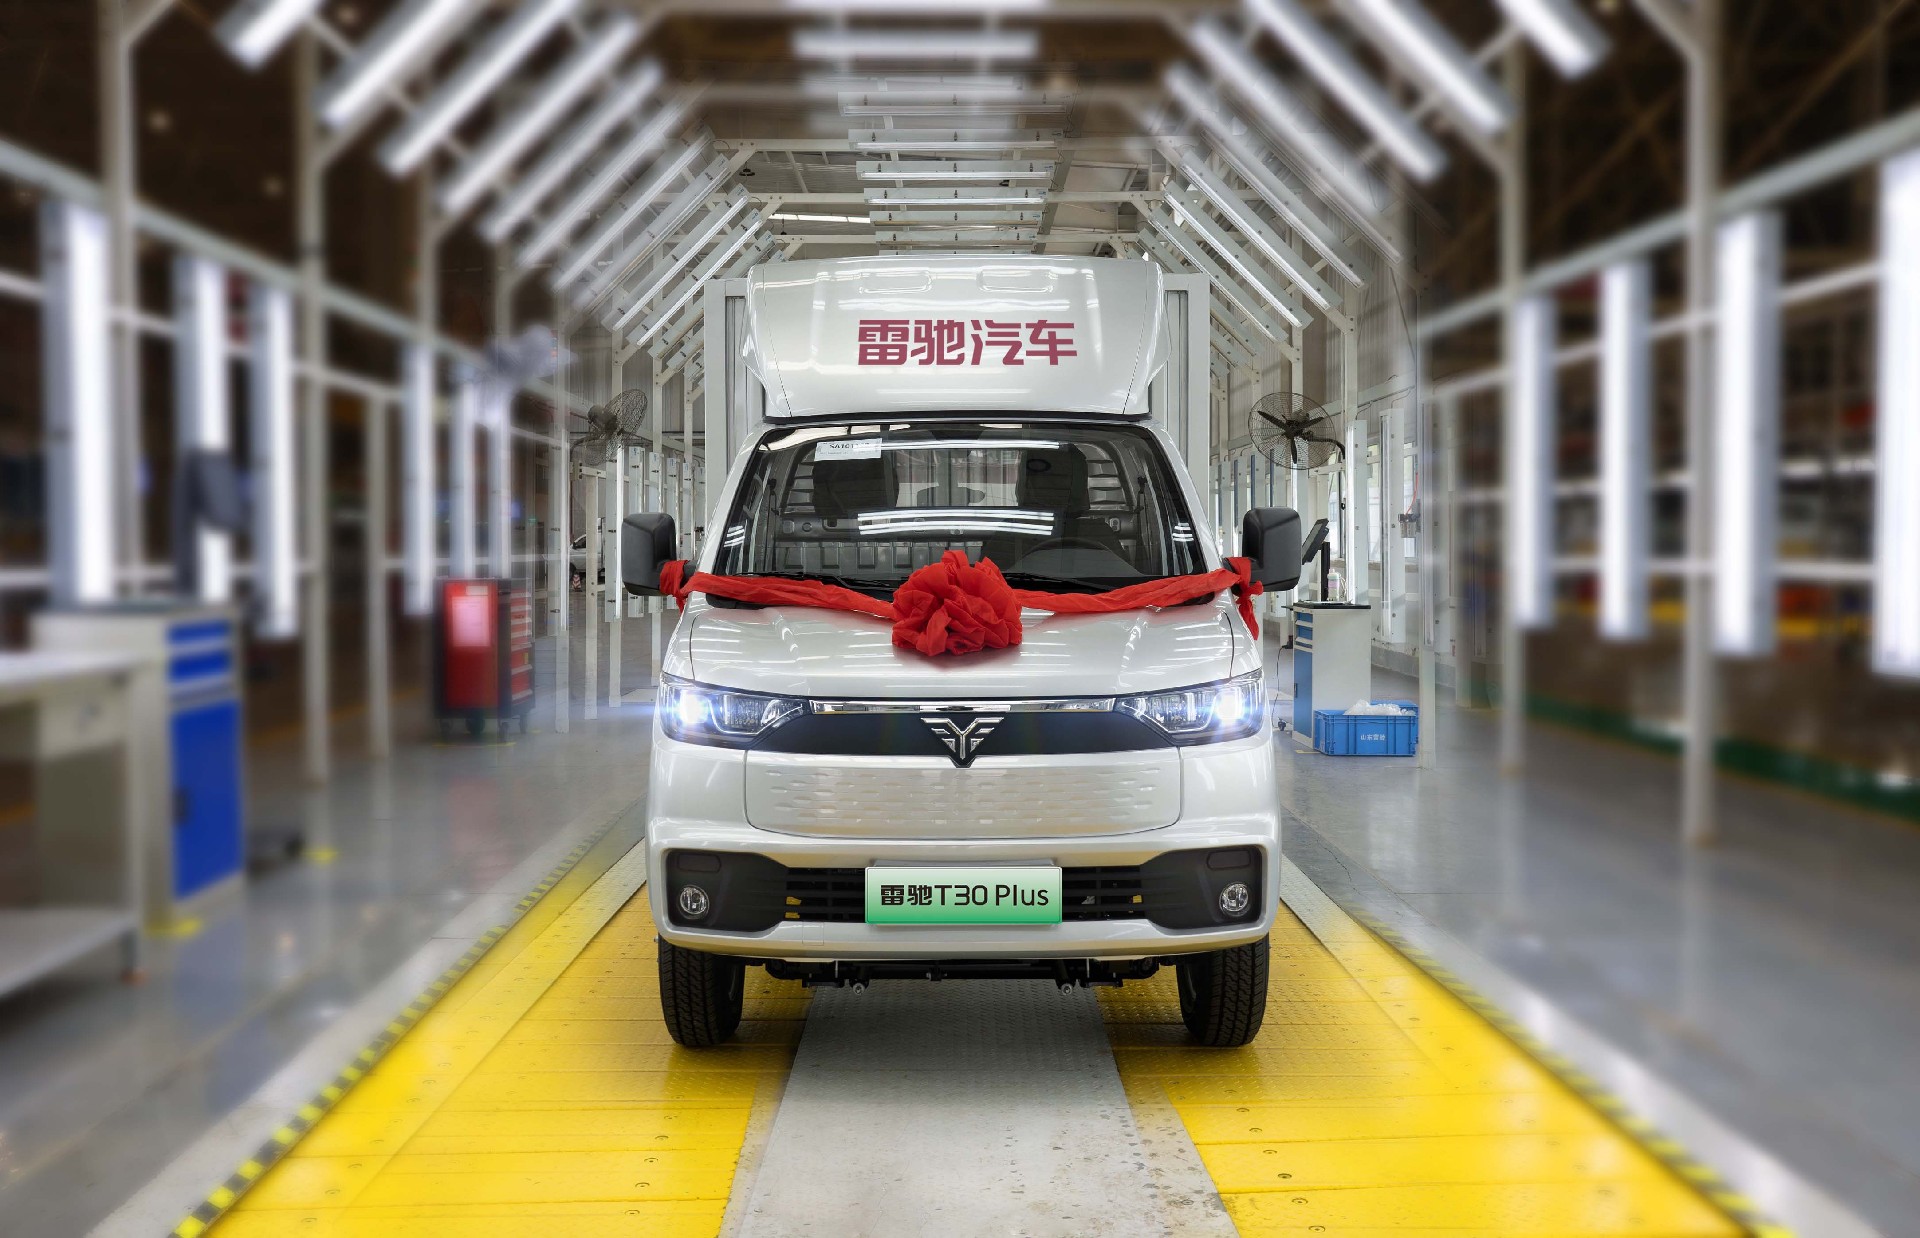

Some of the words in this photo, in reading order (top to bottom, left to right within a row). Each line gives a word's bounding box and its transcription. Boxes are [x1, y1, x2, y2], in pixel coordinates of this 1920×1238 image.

[858, 319, 1078, 366] 雷驰汽车
[880, 884, 988, 906] 雷驰T30
[995, 884, 1049, 907] Plus
